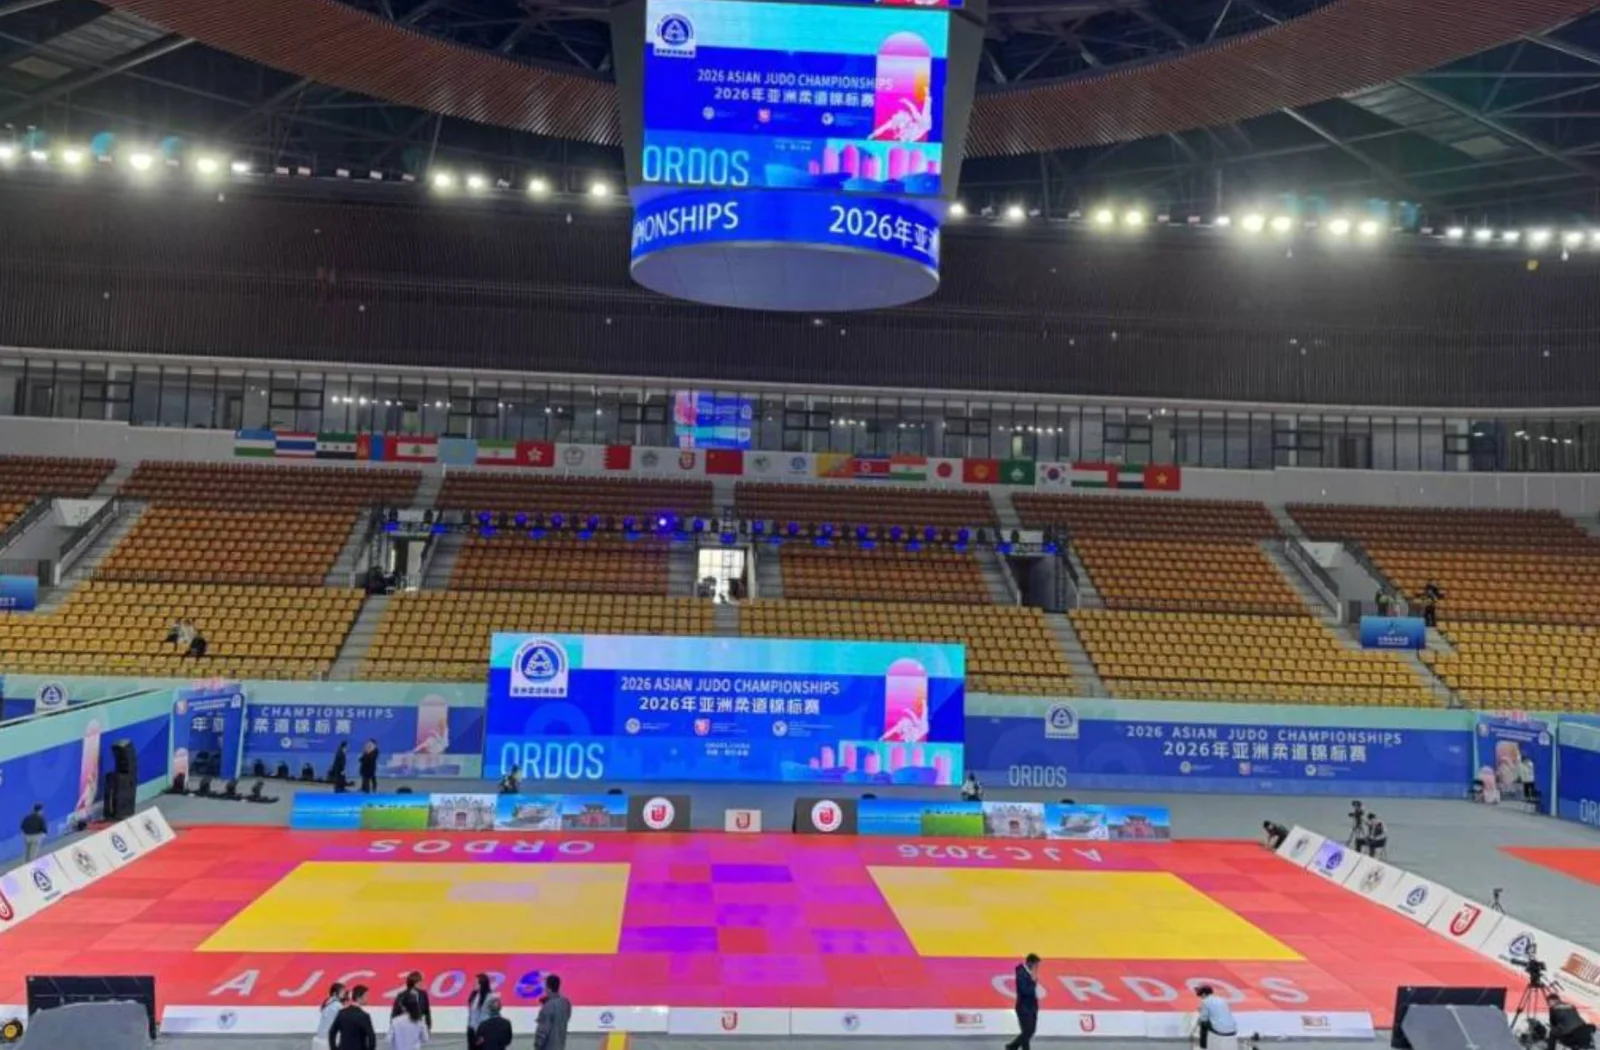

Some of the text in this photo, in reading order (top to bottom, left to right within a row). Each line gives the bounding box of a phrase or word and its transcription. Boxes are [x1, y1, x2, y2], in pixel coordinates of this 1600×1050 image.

[697, 69, 893, 91] 2026 ASIAN JUDO CHAMPIONSHIPS
[642, 145, 750, 186] ORDOS
[621, 676, 840, 697] 2026 ASIAN JUDO CHAMPIONSHIPS
[261, 706, 394, 719] CHAMPIONSHIPS
[1126, 725, 1402, 745] 2026 ASIAN JUDO CHAMPIONSHIPS
[500, 742, 604, 779] ORDOS
[1009, 765, 1067, 788] ORDOS
[368, 840, 595, 853] ORDOS
[991, 974, 1309, 1005] ORDOS
